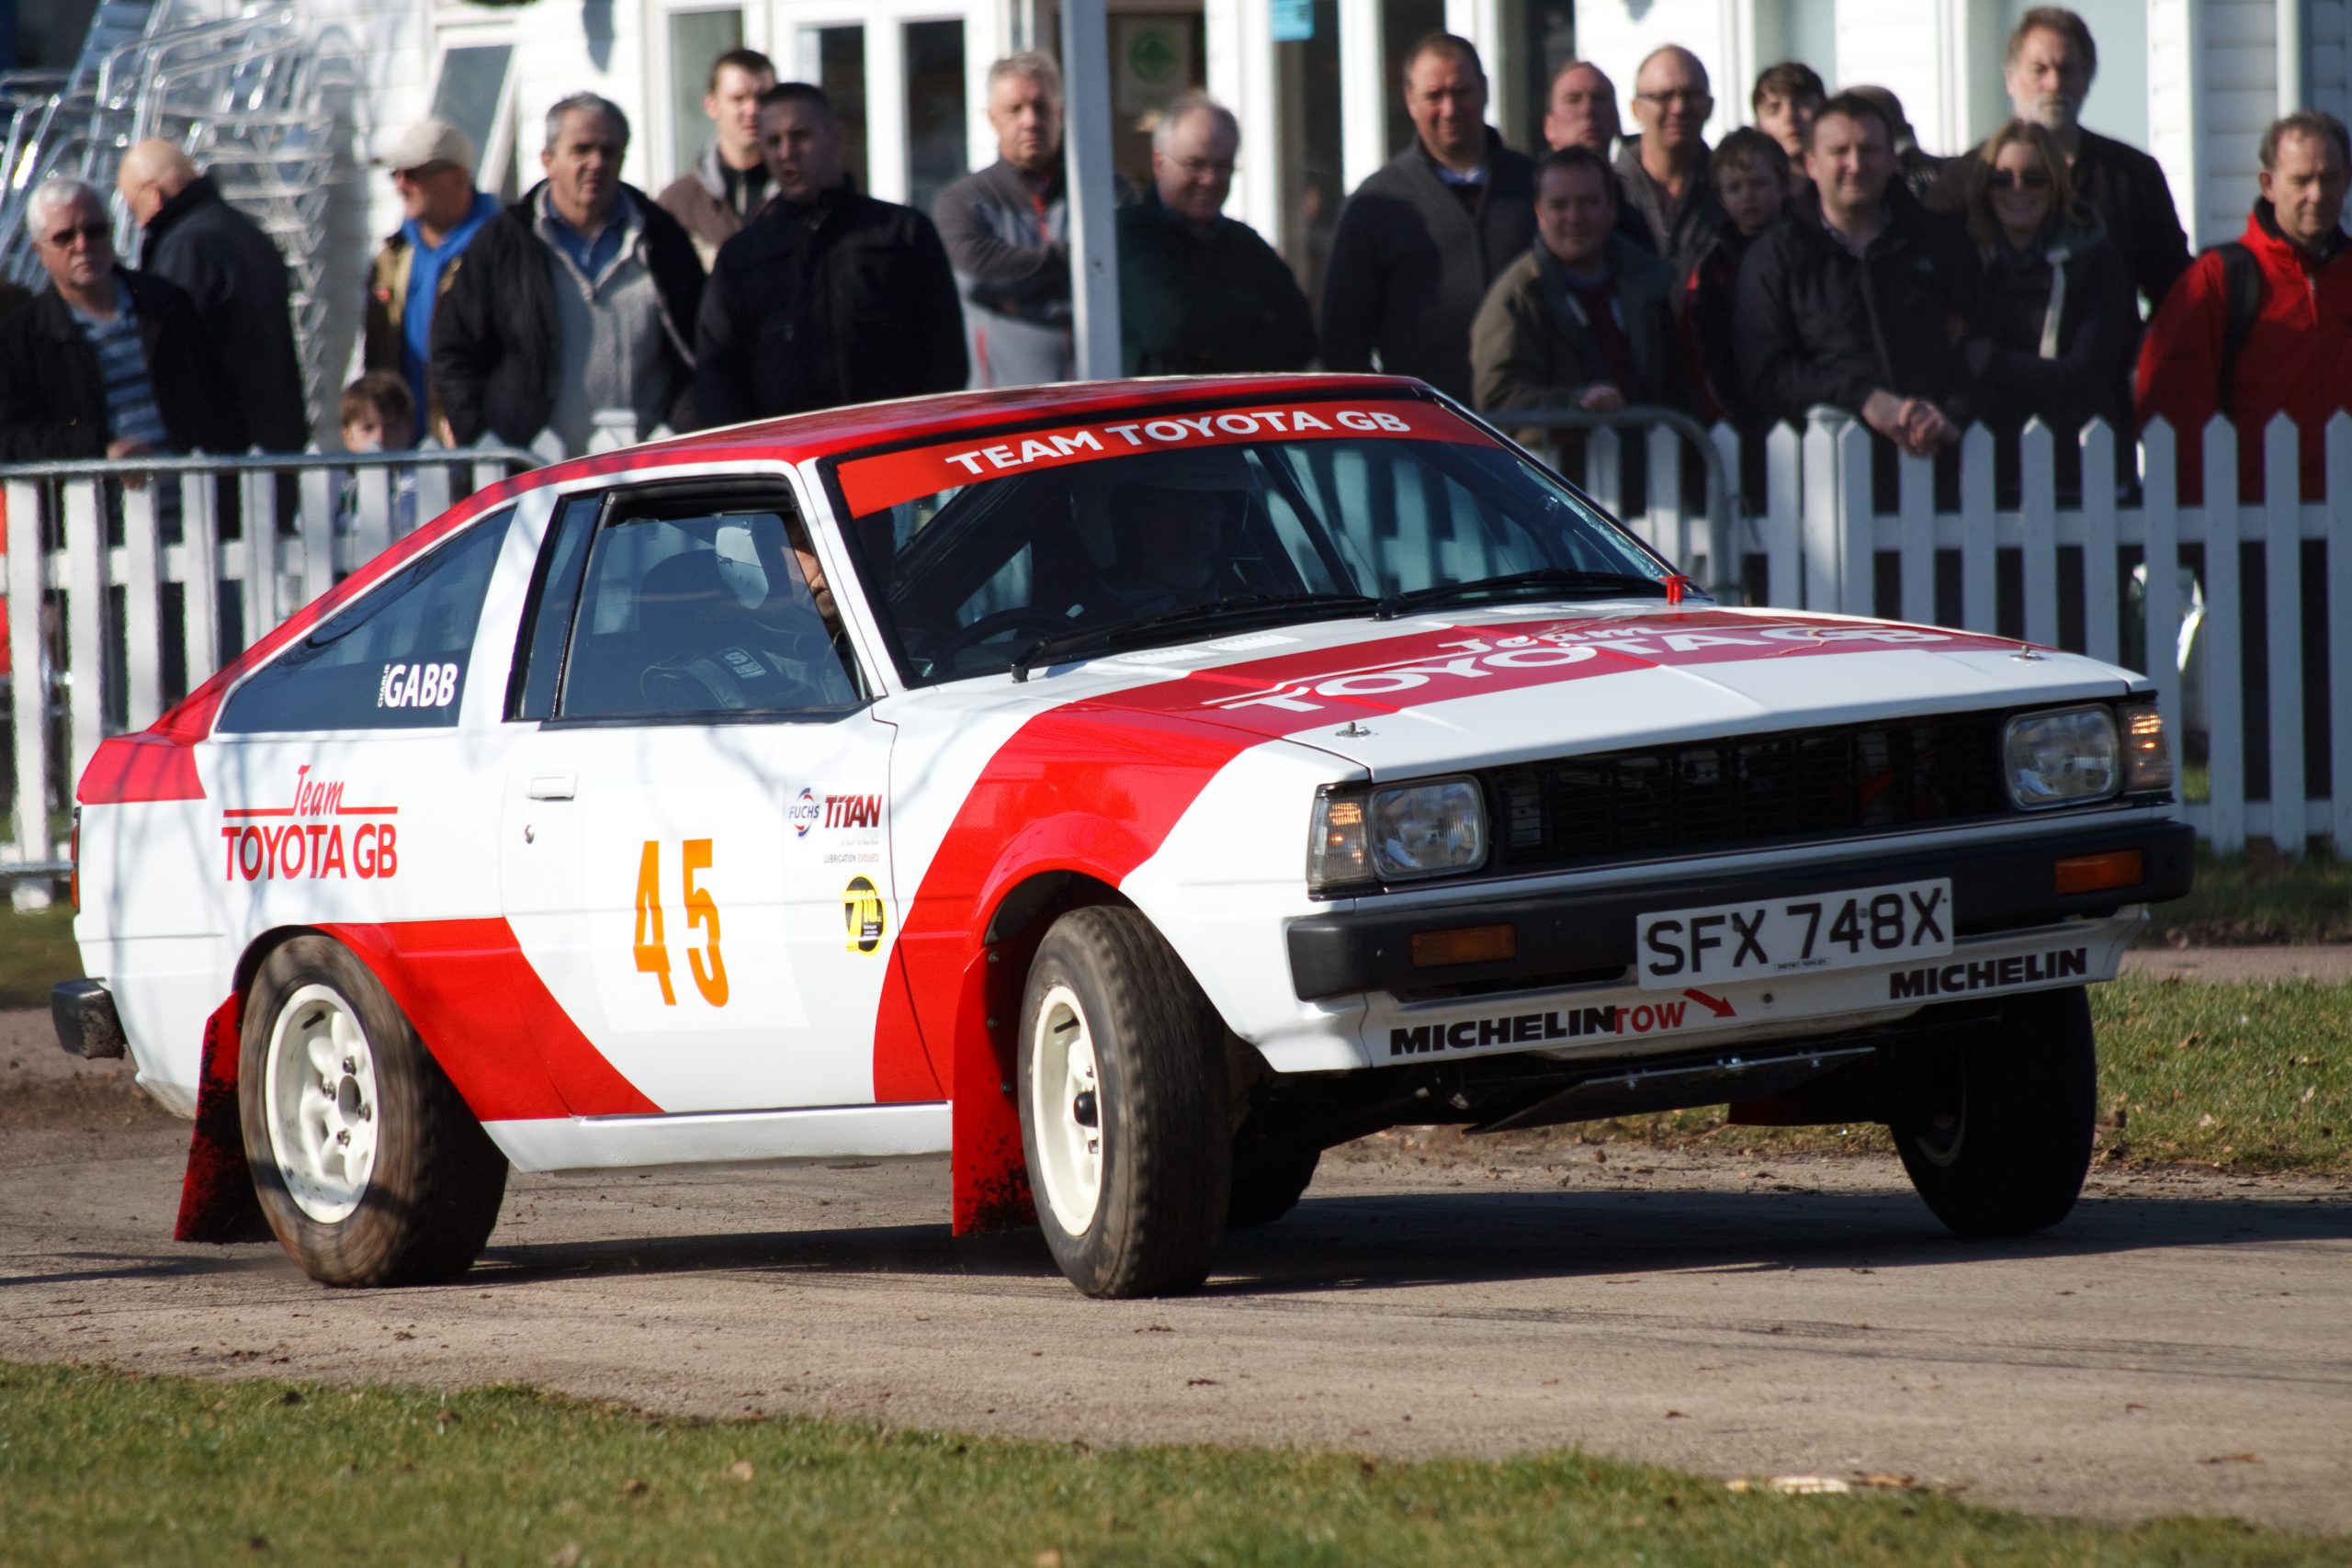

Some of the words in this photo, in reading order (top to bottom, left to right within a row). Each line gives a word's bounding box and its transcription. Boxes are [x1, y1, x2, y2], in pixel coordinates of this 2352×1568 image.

[944, 430, 1103, 475] TEAM
[1104, 411, 1334, 446] TOYOTA
[1336, 410, 1411, 433] GB
[1448, 626, 1655, 653] Team
[385, 663, 458, 707] GABB
[1220, 633, 1776, 713] TOYOTA
[1758, 626, 1954, 643] GB
[292, 764, 345, 817] Team
[788, 805, 820, 819] FUCHS
[221, 824, 347, 881] TOYOTA
[353, 823, 398, 880] GB
[823, 853, 856, 863] LUBRICATION
[633, 839, 729, 1008] 45
[1646, 909, 1769, 976] SFX
[1786, 887, 1945, 959] 748X
[1890, 947, 2086, 999] MICHELIN
[1390, 1005, 1616, 1055] MICHELIN
[1614, 1001, 1687, 1034] TOW
